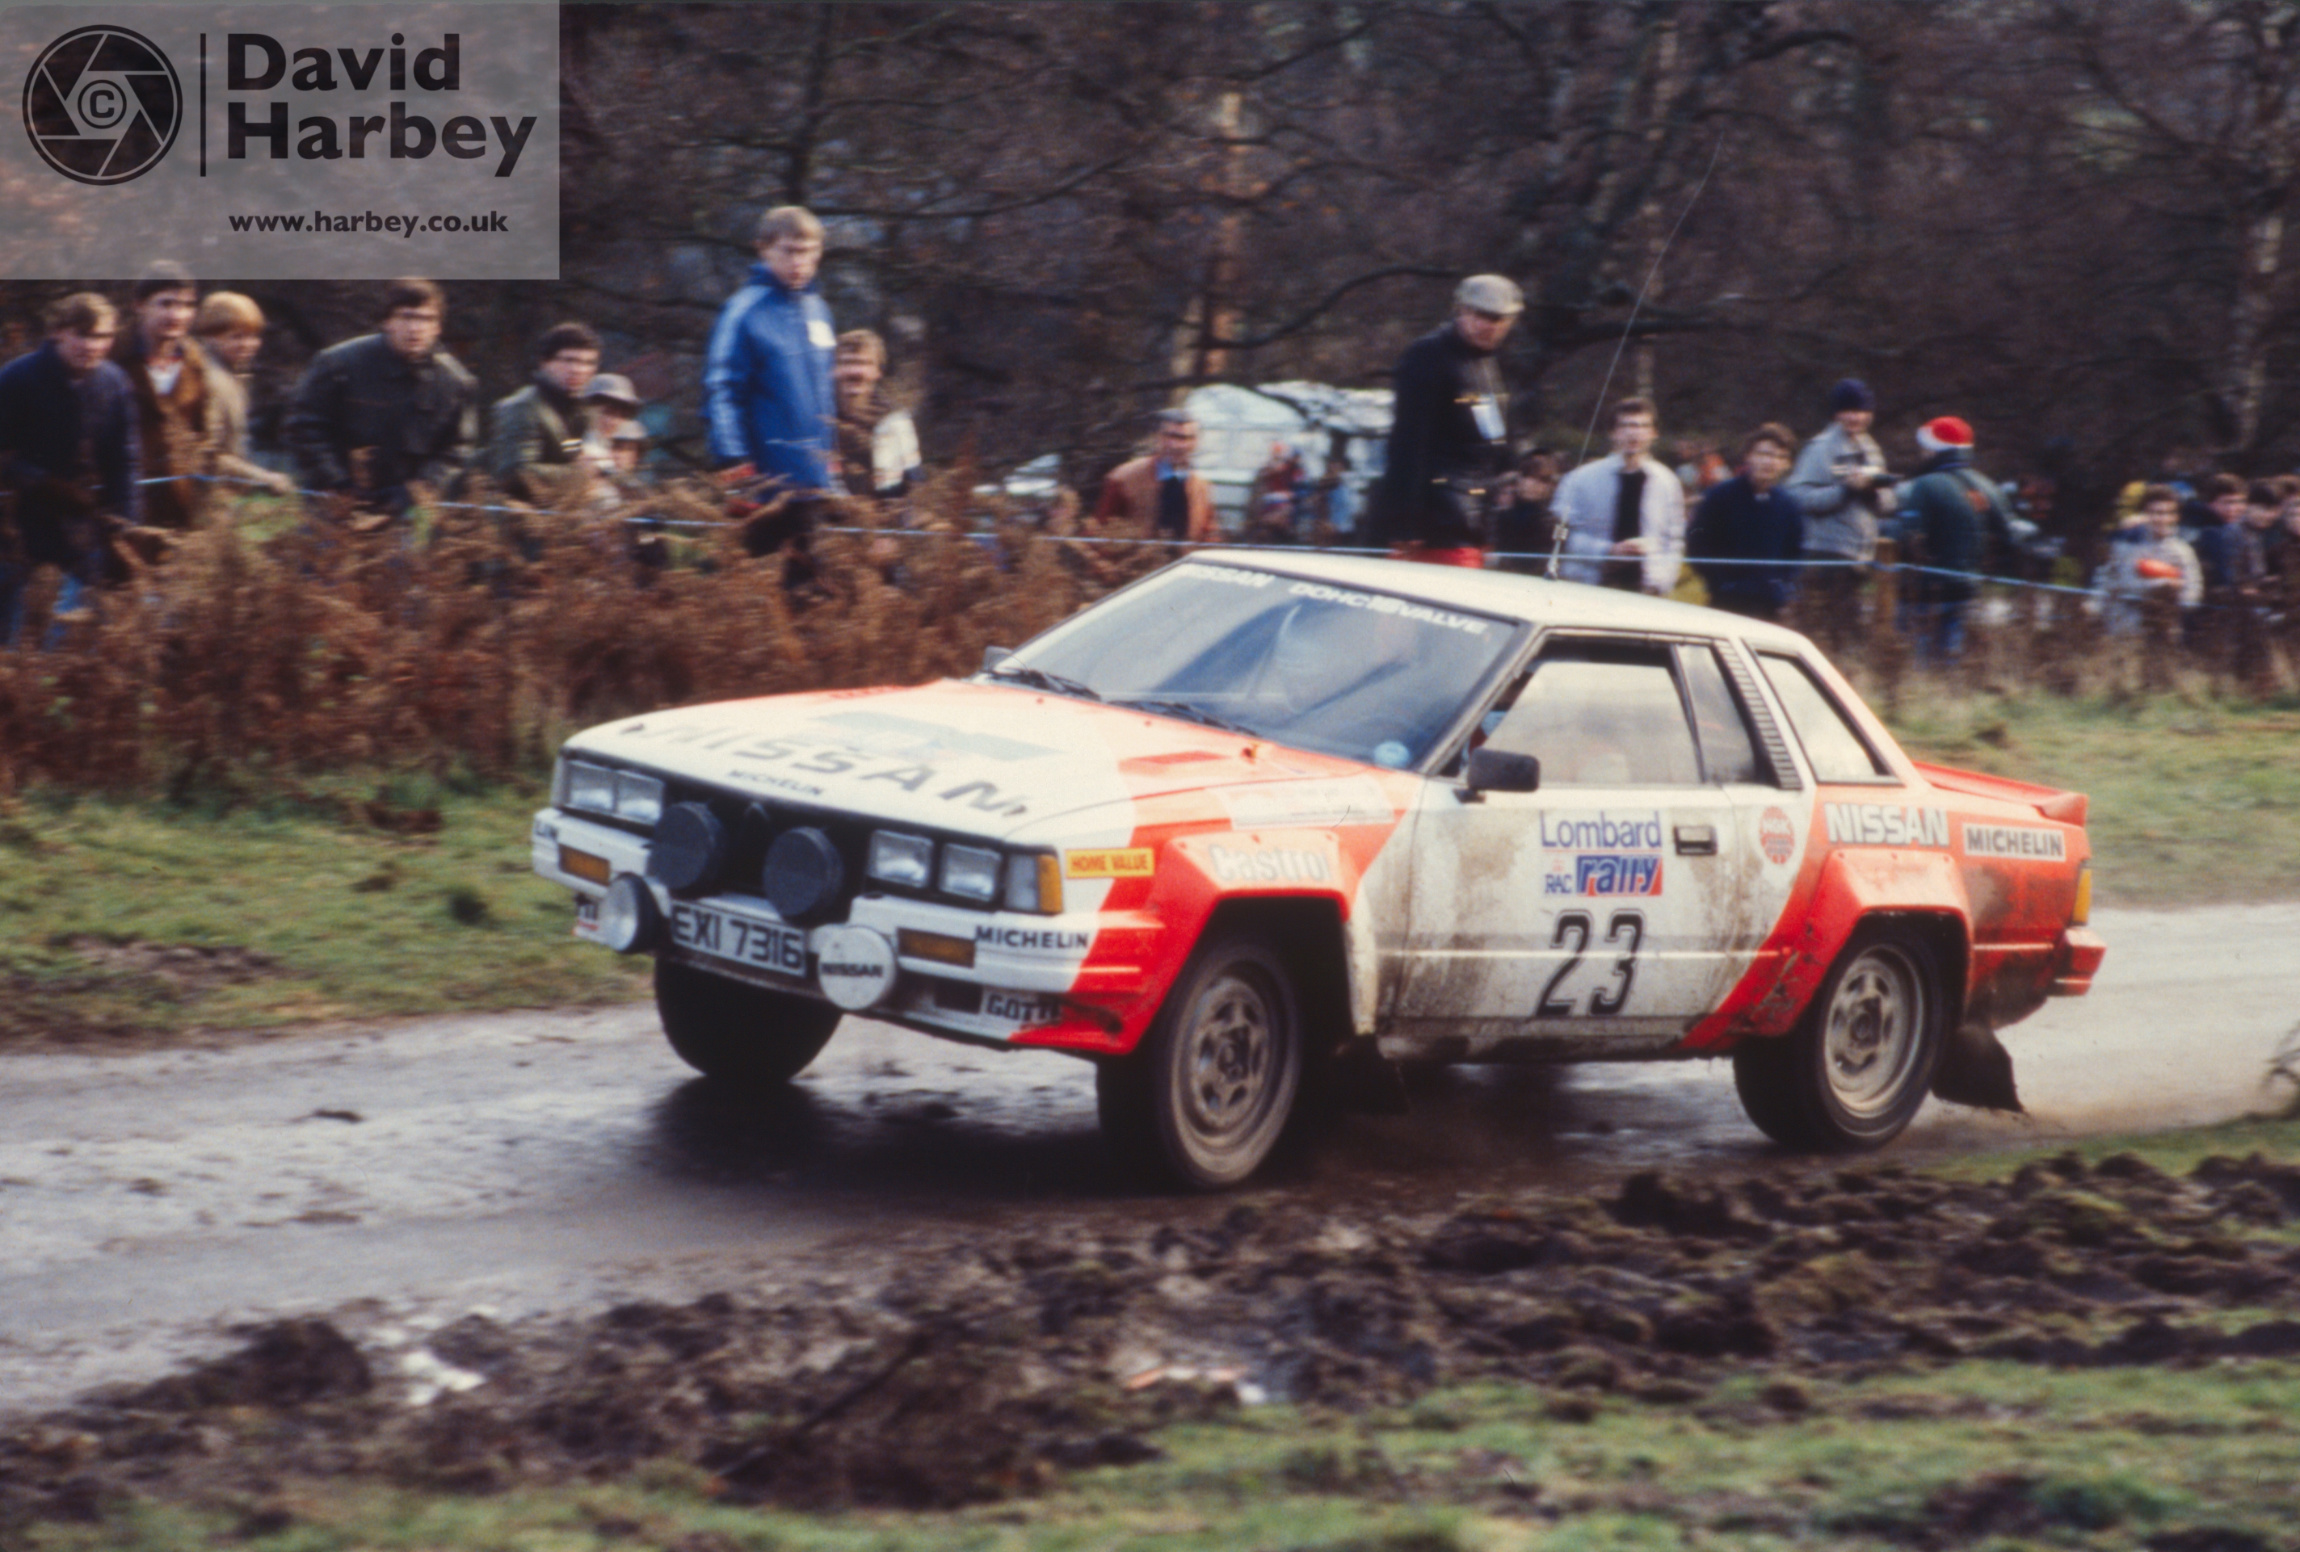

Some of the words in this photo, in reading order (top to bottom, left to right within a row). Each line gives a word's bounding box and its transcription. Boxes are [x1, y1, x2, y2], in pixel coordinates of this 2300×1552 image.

[646, 722, 1028, 817] NISSAN
[1540, 810, 1661, 848] Lombard
[1825, 803, 1949, 846] NISSAN
[1966, 828, 2065, 857] MICHELIN
[1070, 854, 1107, 872] HOME
[1111, 853, 1148, 871] VALUE
[1208, 843, 1331, 882] Castrol
[1544, 873, 1572, 894] RAC
[1579, 857, 1660, 894] rally
[672, 904, 721, 952] EXI
[729, 918, 804, 970] 7316
[975, 925, 1089, 949] MICHELIN
[820, 961, 884, 978] NISSAN
[1535, 908, 1645, 1017] 23
